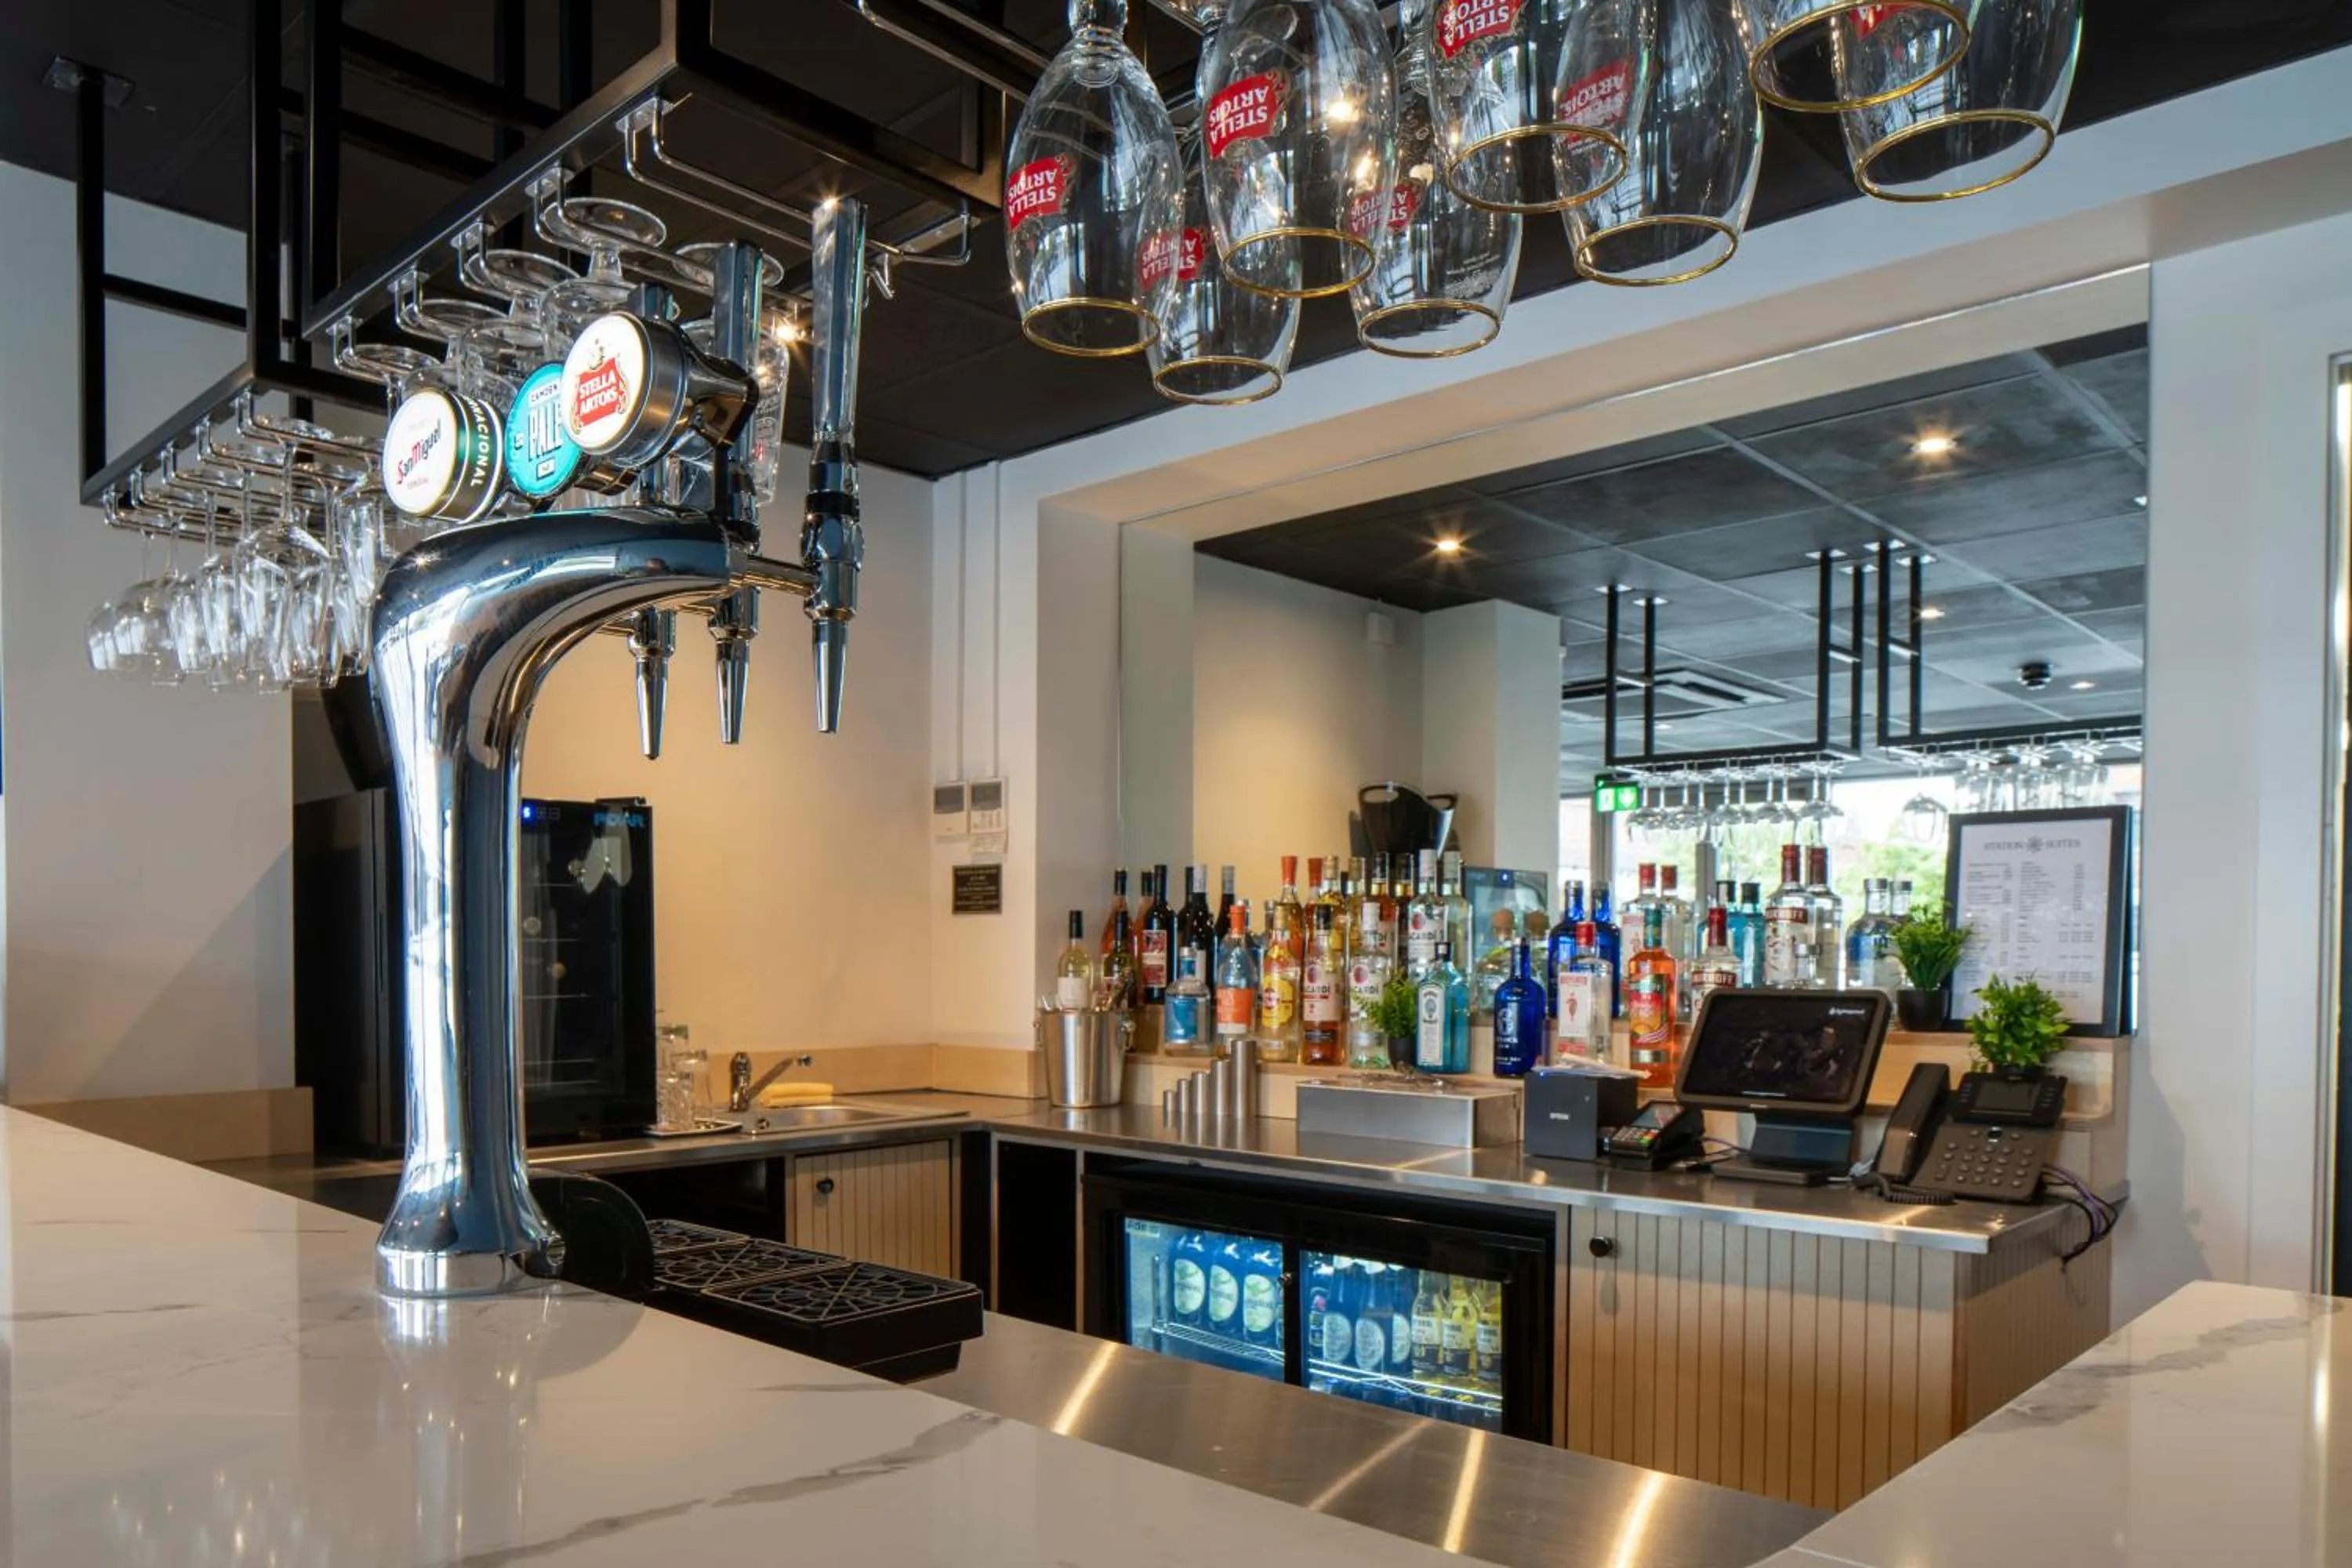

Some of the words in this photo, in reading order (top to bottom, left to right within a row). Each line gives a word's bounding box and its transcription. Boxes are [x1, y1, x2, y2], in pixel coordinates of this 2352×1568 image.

[1443, 0, 1506, 29] RTOIS
[1444, 5, 1509, 46] STELLA
[1209, 85, 1269, 128] ARTOIS
[1210, 106, 1268, 145] STELLA
[1007, 168, 1058, 203] ARTOIS
[1008, 186, 1057, 220] STELLA
[1142, 254, 1196, 280] STELLA
[579, 370, 618, 399] STELLA
[579, 387, 619, 415] ARTOIS
